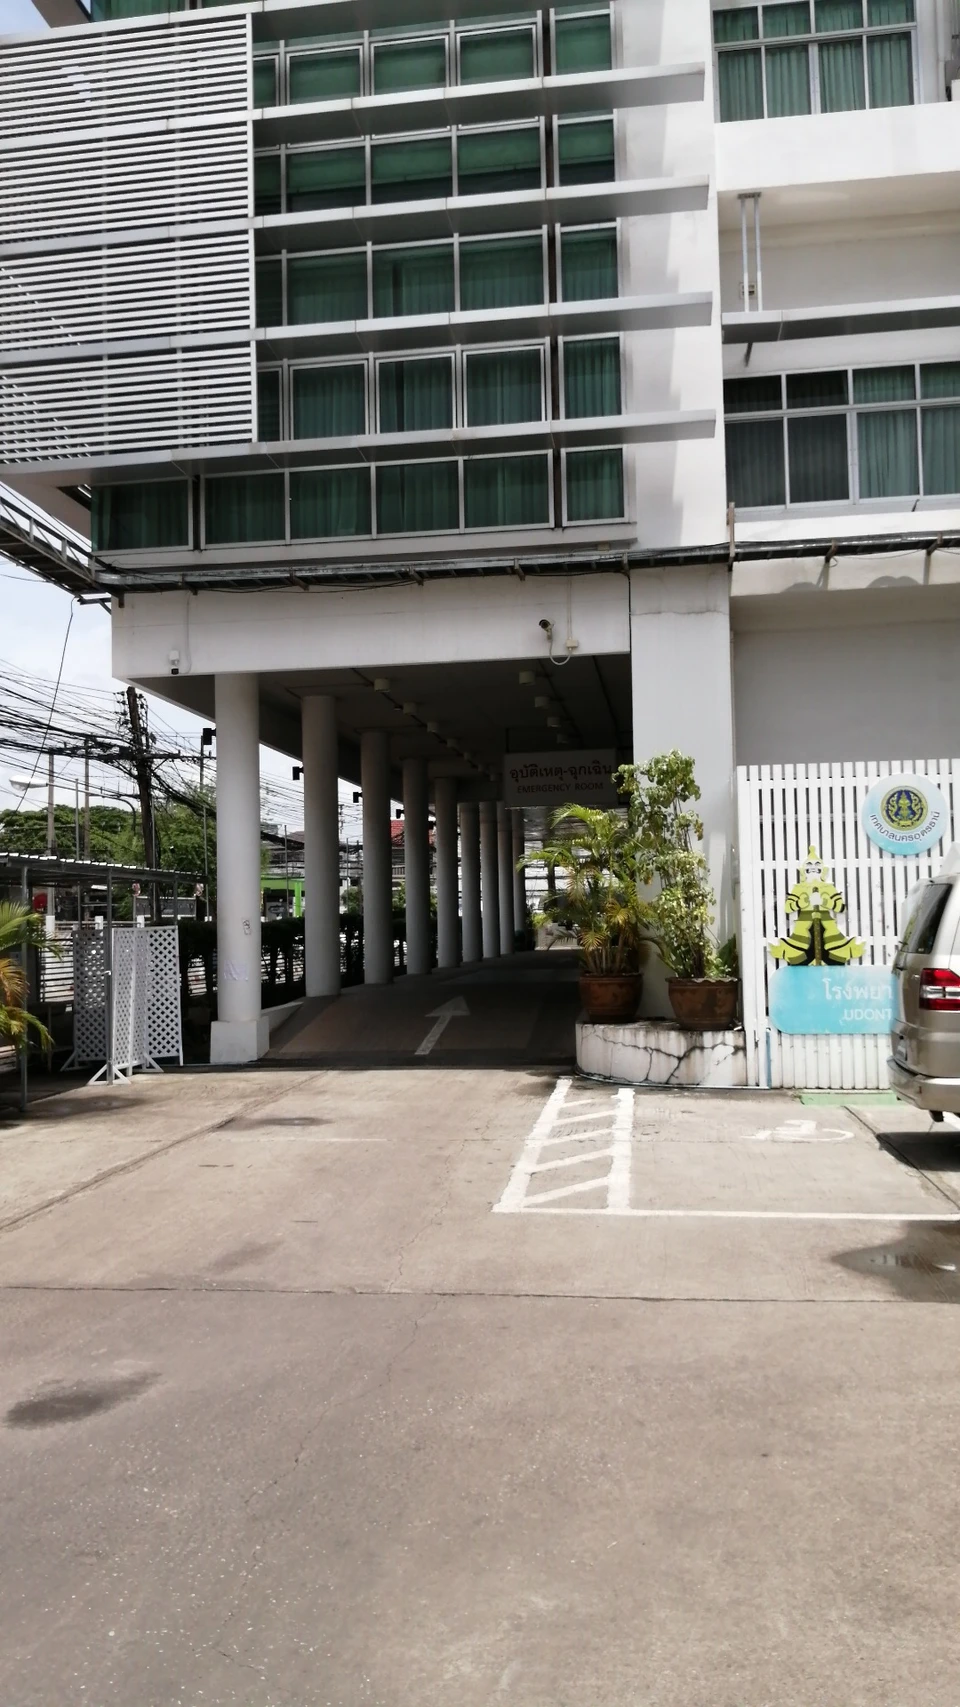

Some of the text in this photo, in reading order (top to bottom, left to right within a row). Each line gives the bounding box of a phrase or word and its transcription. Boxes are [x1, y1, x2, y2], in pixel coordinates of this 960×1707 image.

[510, 760, 612, 783] อุบัติเหตุ-ฉุกเฉิน
[517, 782, 604, 794] EMERGENCY ROOM
[869, 810, 941, 842] เทศบาลนครอุดรธานี
